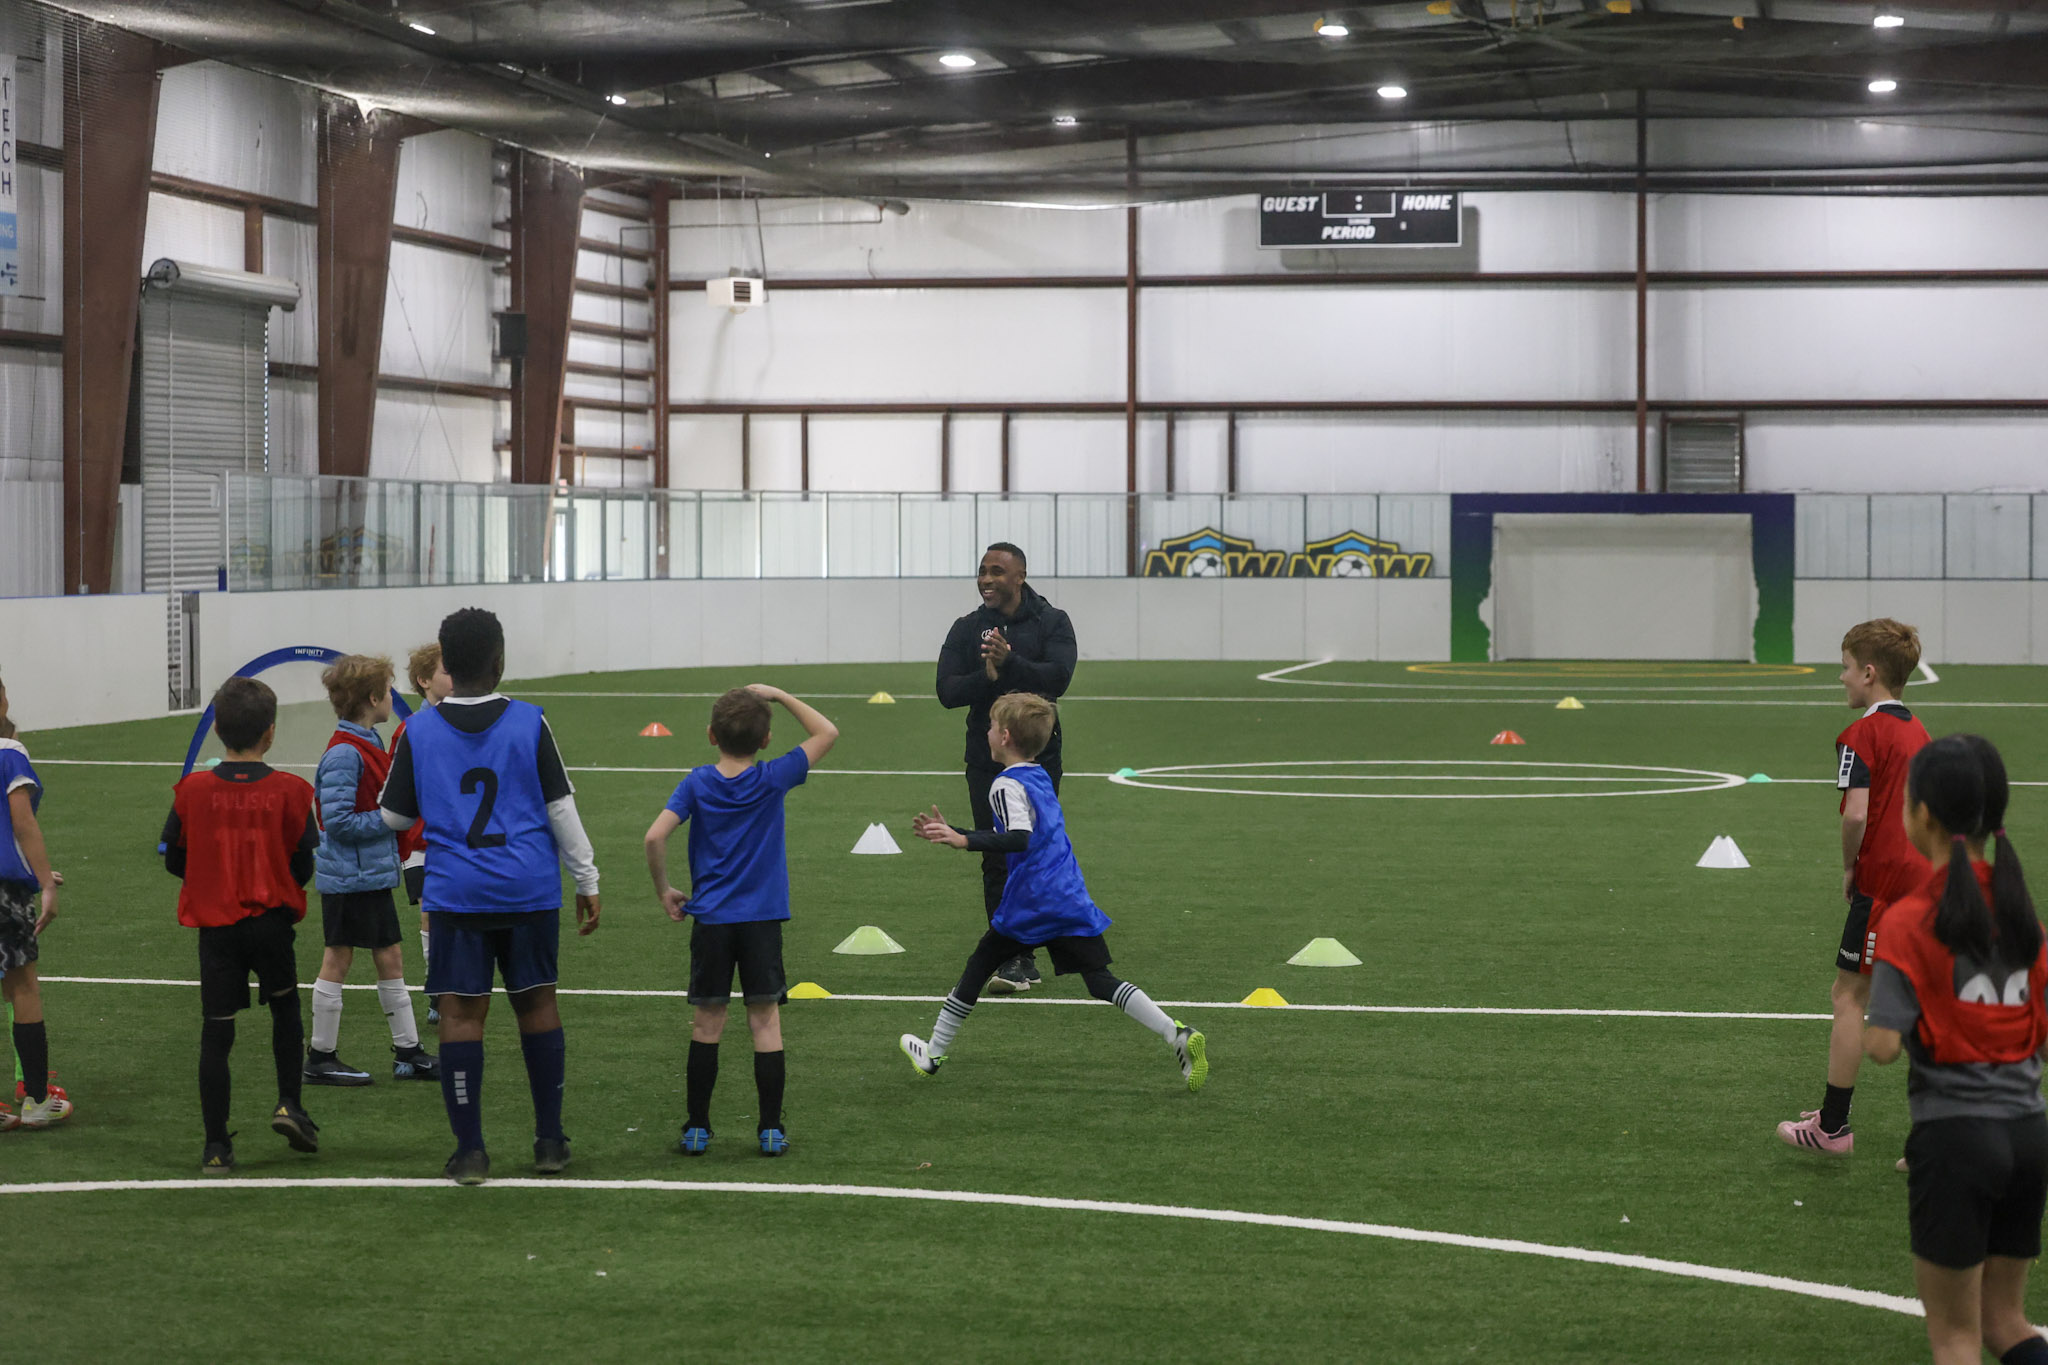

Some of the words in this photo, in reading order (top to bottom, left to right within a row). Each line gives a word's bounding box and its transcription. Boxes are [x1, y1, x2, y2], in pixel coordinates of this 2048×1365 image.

[1, 78, 11, 195] TECH
[1262, 196, 1319, 212] GUEST
[1402, 194, 1453, 211] HOME
[1321, 226, 1376, 240] PERIOD
[1144, 548, 1285, 577] NOW
[295, 648, 324, 657] INFINITY
[460, 767, 506, 849] 2
